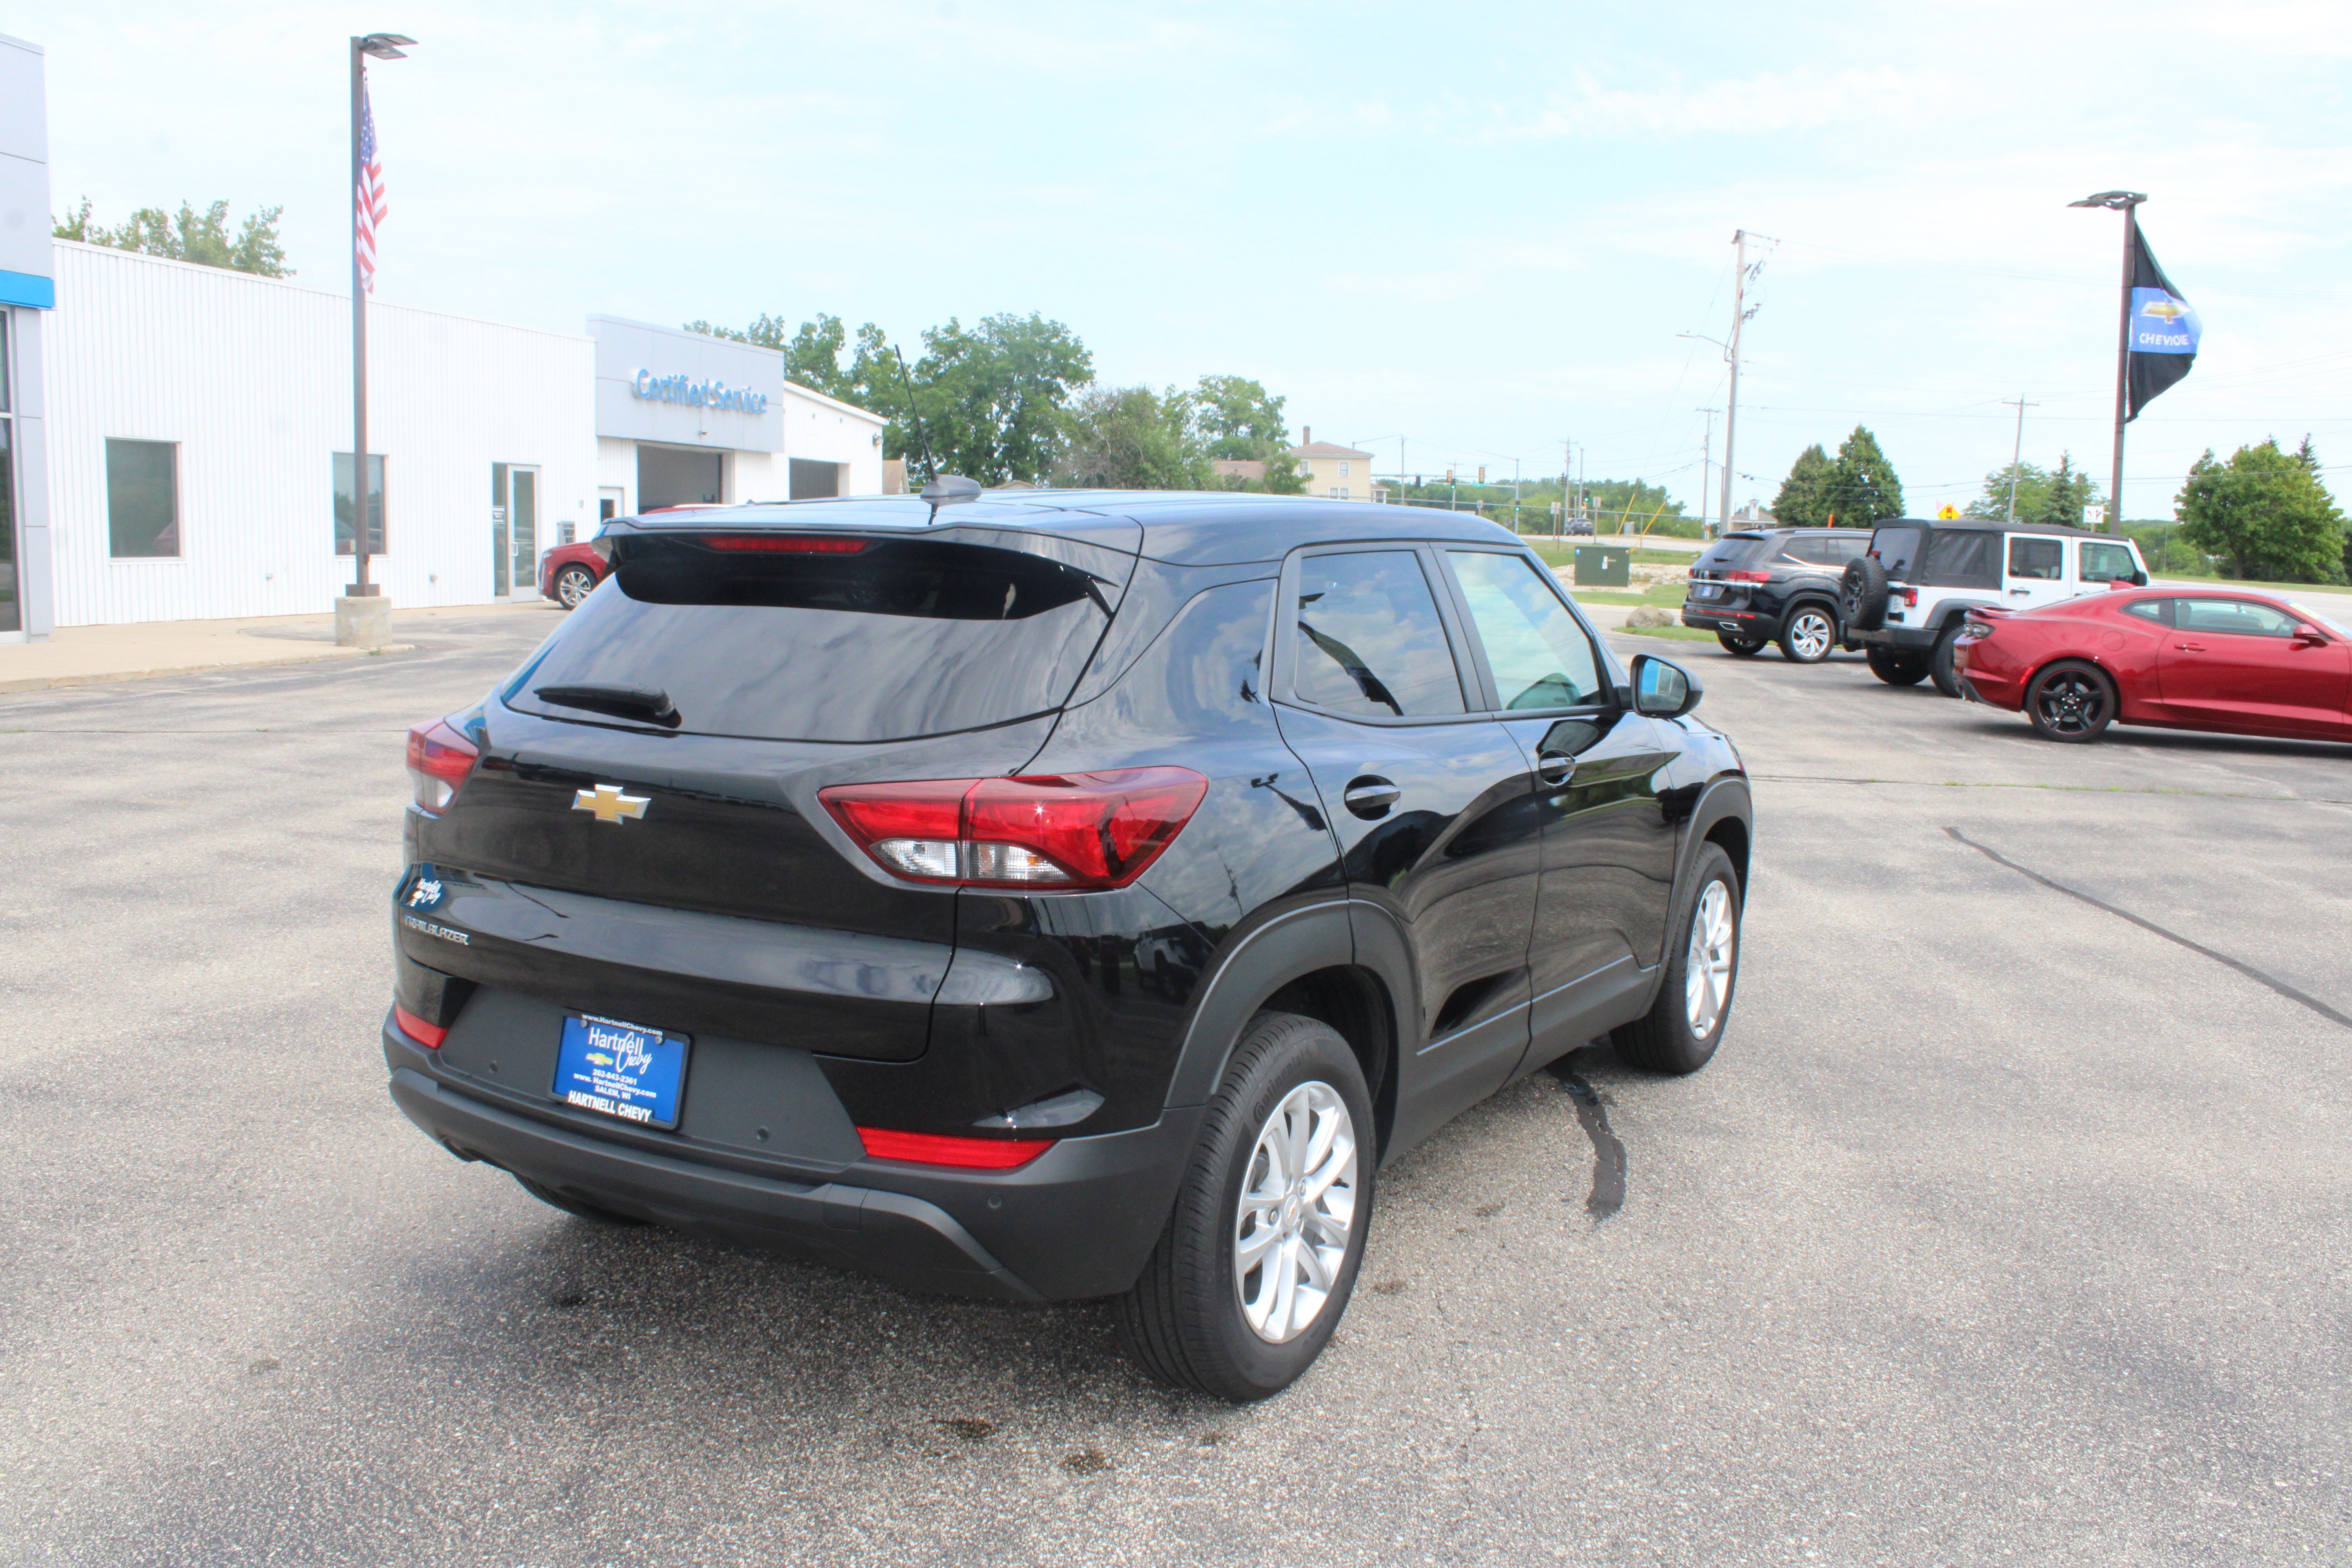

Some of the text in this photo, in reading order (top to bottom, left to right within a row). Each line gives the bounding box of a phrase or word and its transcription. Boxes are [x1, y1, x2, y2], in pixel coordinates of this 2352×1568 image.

[2139, 333, 2189, 346] CHEVOE
[636, 368, 768, 414] Certified Service
[405, 915, 470, 945] TRAILBLAZER
[581, 1014, 663, 1036] www.HartnellChevy.com
[588, 1027, 644, 1056] Hartnell
[616, 1031, 653, 1075] Chevy
[573, 1073, 657, 1098] www. HartnellChevy.com
[592, 1069, 637, 1085] 262-843-2361
[1253, 1049, 1305, 1125] Continental
[568, 1090, 653, 1122] HARTNELL CHEVY
[595, 1085, 631, 1100] SALEM, WI
